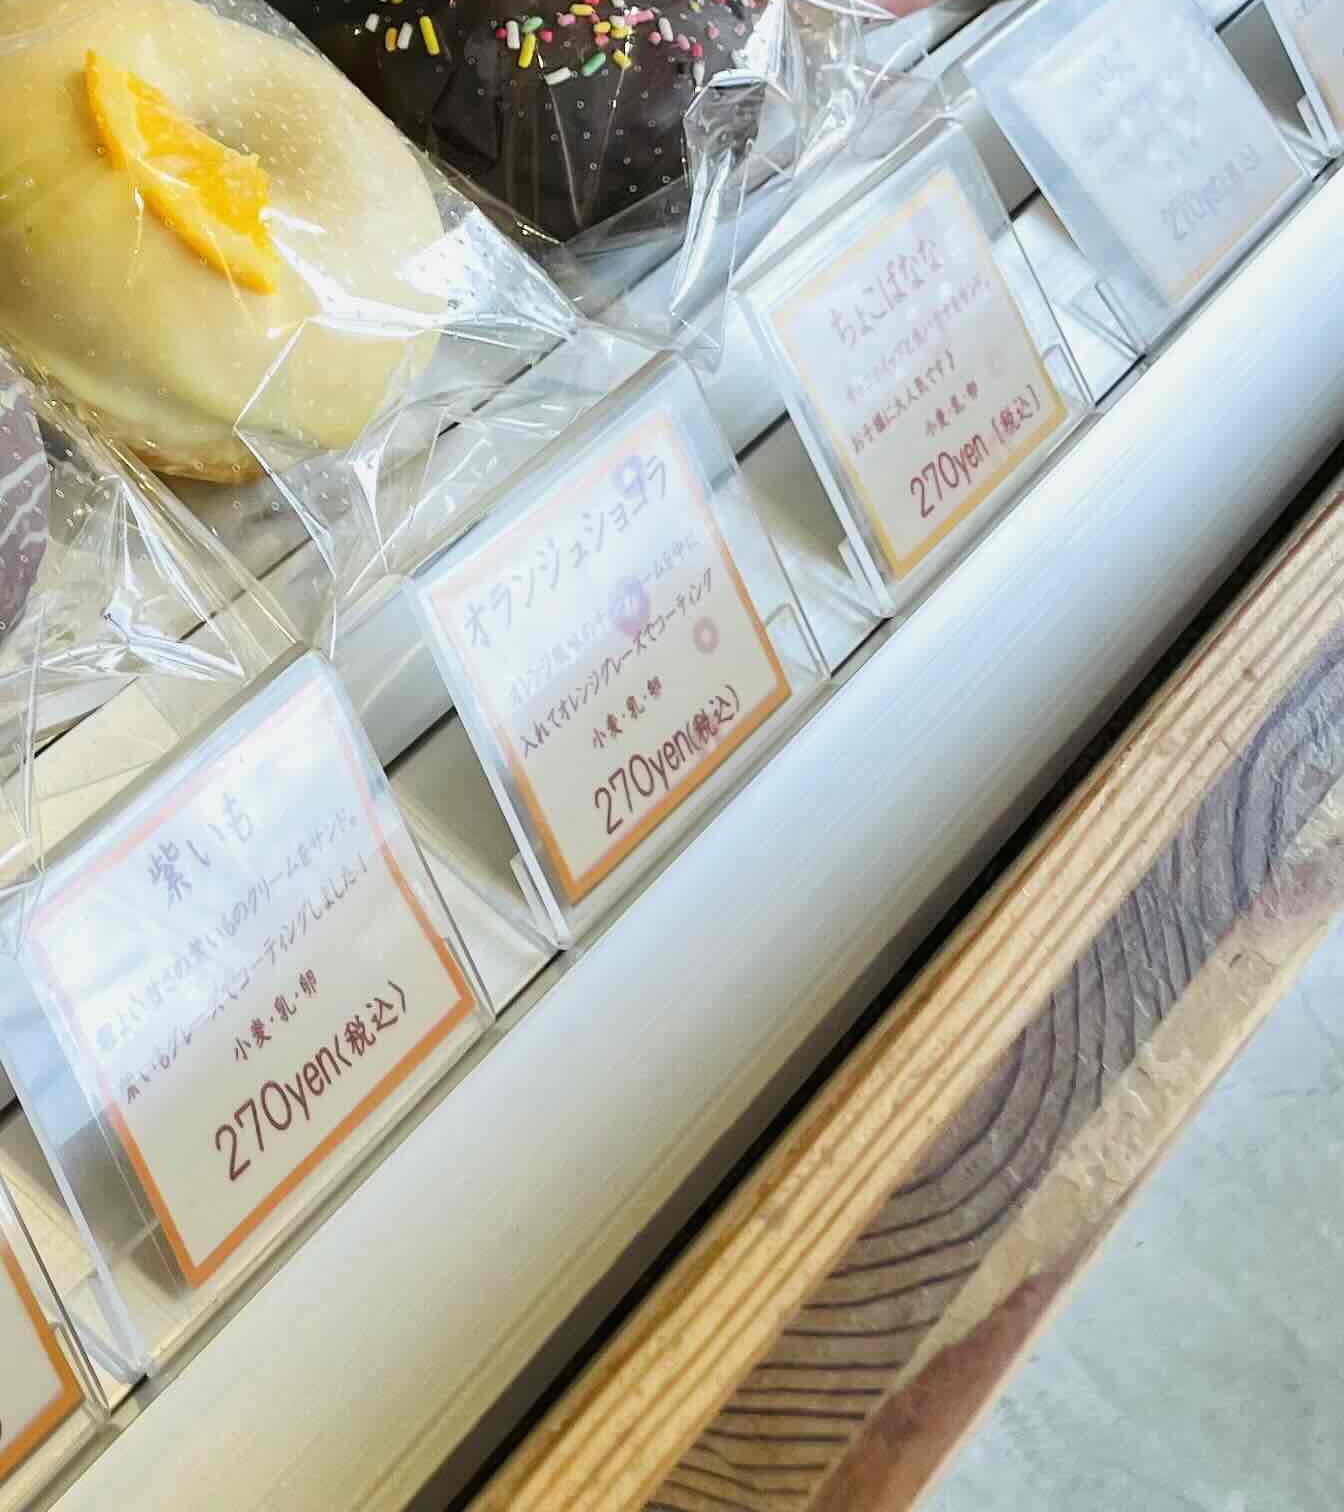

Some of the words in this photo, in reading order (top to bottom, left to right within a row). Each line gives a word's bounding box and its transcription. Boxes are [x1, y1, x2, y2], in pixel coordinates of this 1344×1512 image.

[829, 238, 943, 348] ちょこばなな
[464, 455, 668, 649] オランジュショコラ
[148, 792, 255, 908] 紫いも
[232, 968, 321, 1063] 小麦・乳・卵
